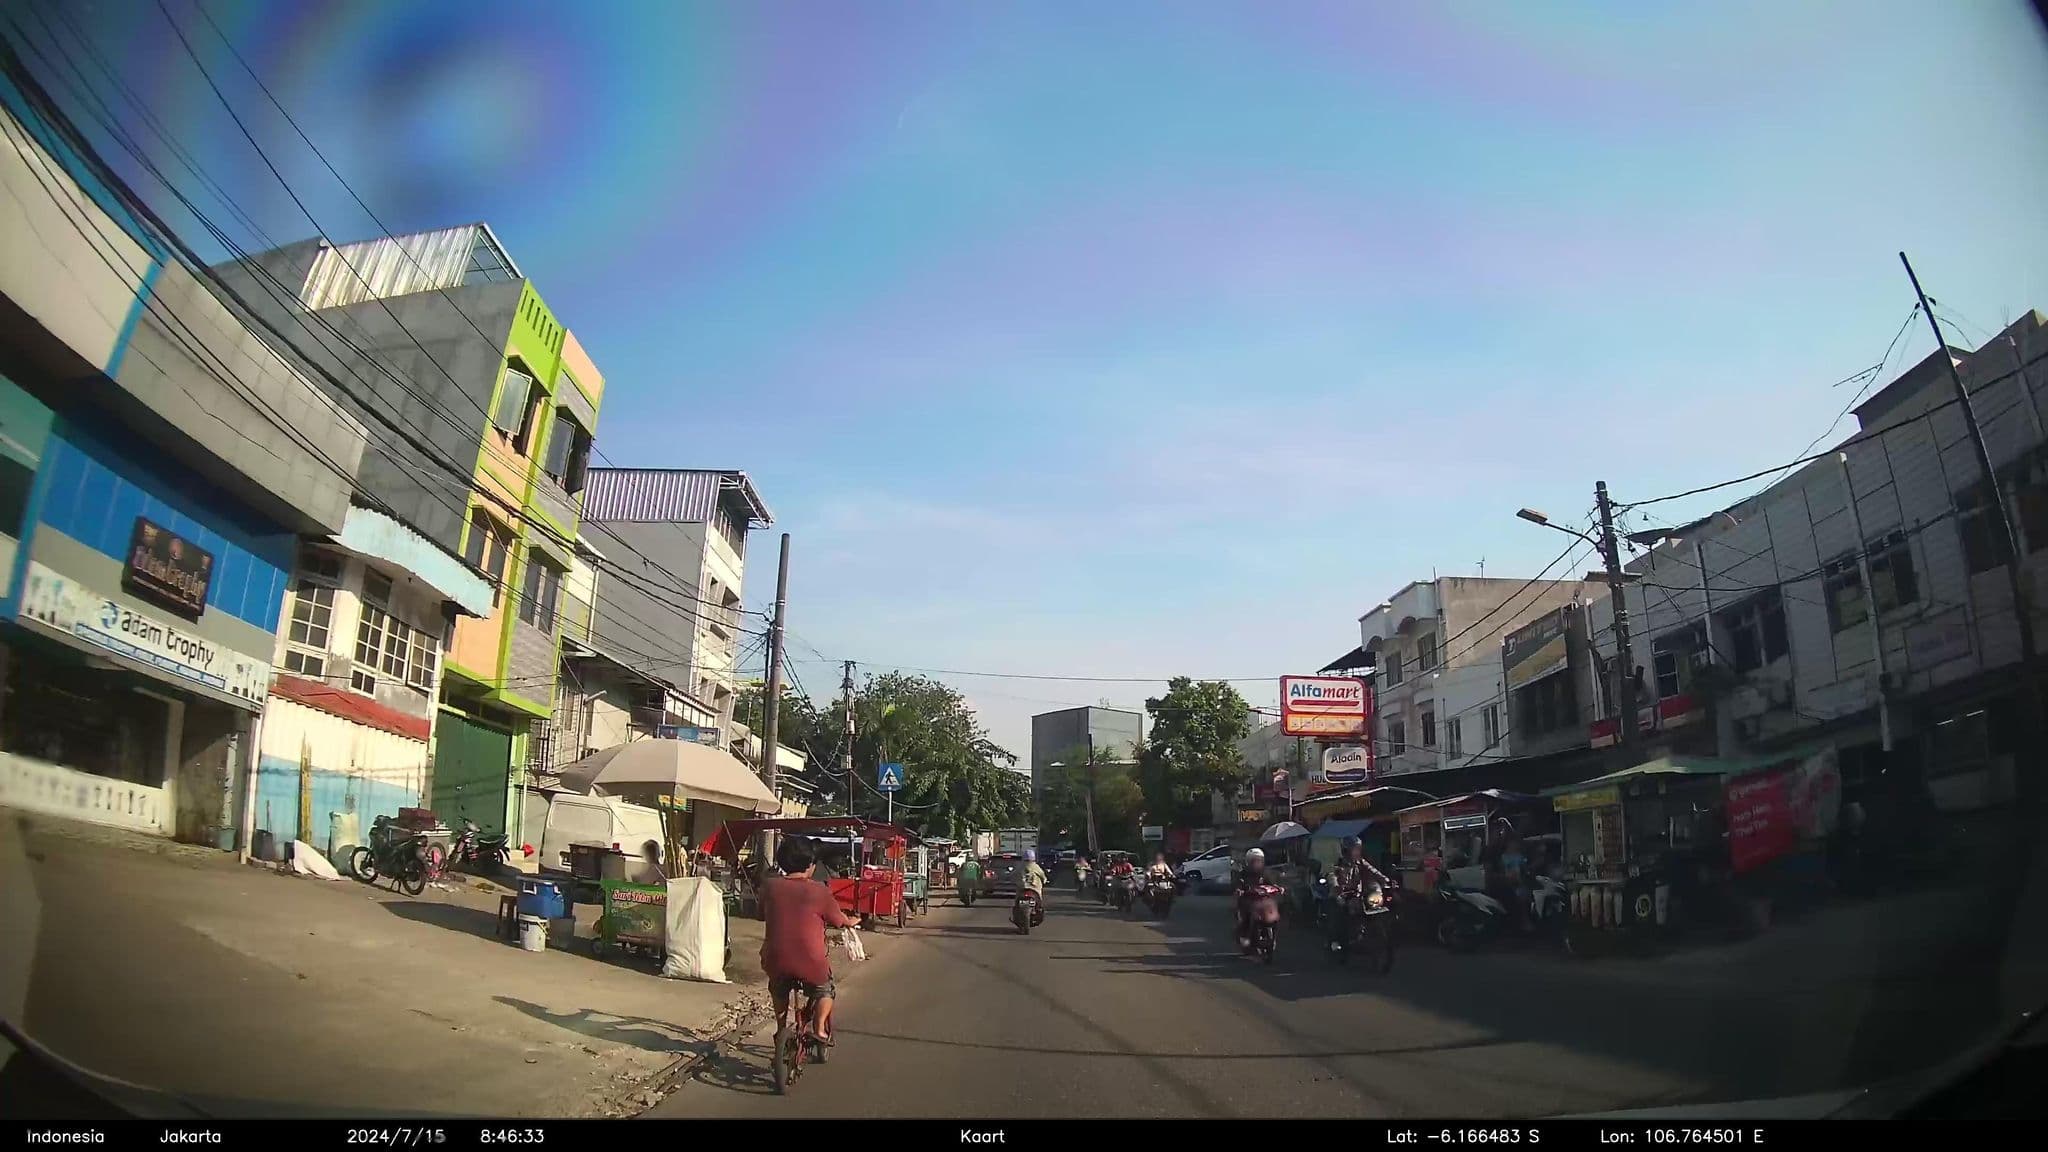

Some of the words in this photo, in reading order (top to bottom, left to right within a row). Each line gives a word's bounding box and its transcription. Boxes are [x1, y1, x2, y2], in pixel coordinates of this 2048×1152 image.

[121, 611, 162, 645] adam
[166, 627, 215, 670] trophy
[1290, 683, 1360, 699] Alfamart
